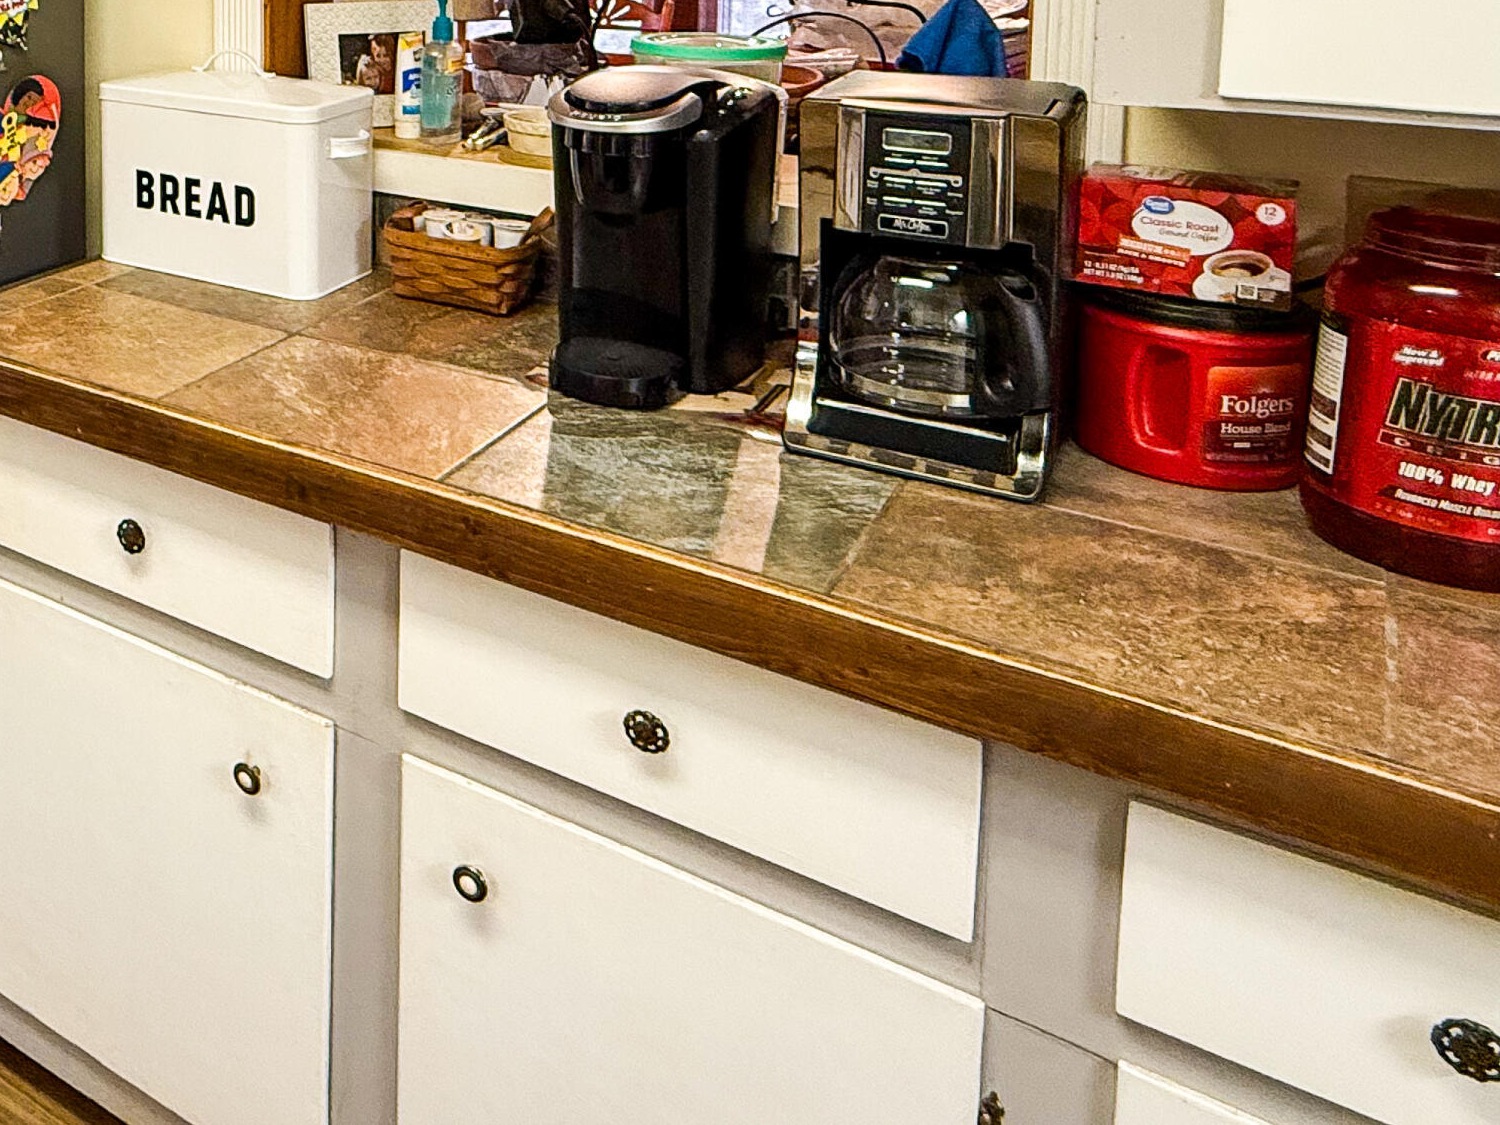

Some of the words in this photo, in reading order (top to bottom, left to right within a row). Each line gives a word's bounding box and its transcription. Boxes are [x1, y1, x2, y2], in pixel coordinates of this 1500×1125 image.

[135, 169, 256, 228] BREAD
[1264, 206, 1278, 217] 12
[1140, 216, 1182, 229] Classic
[1186, 221, 1219, 232] Roast
[1191, 231, 1219, 242] Coffee
[1220, 394, 1294, 418] Folgers
[1221, 423, 1262, 434] House
[1398, 461, 1444, 485] 100%
[1451, 473, 1496, 496] Whey
